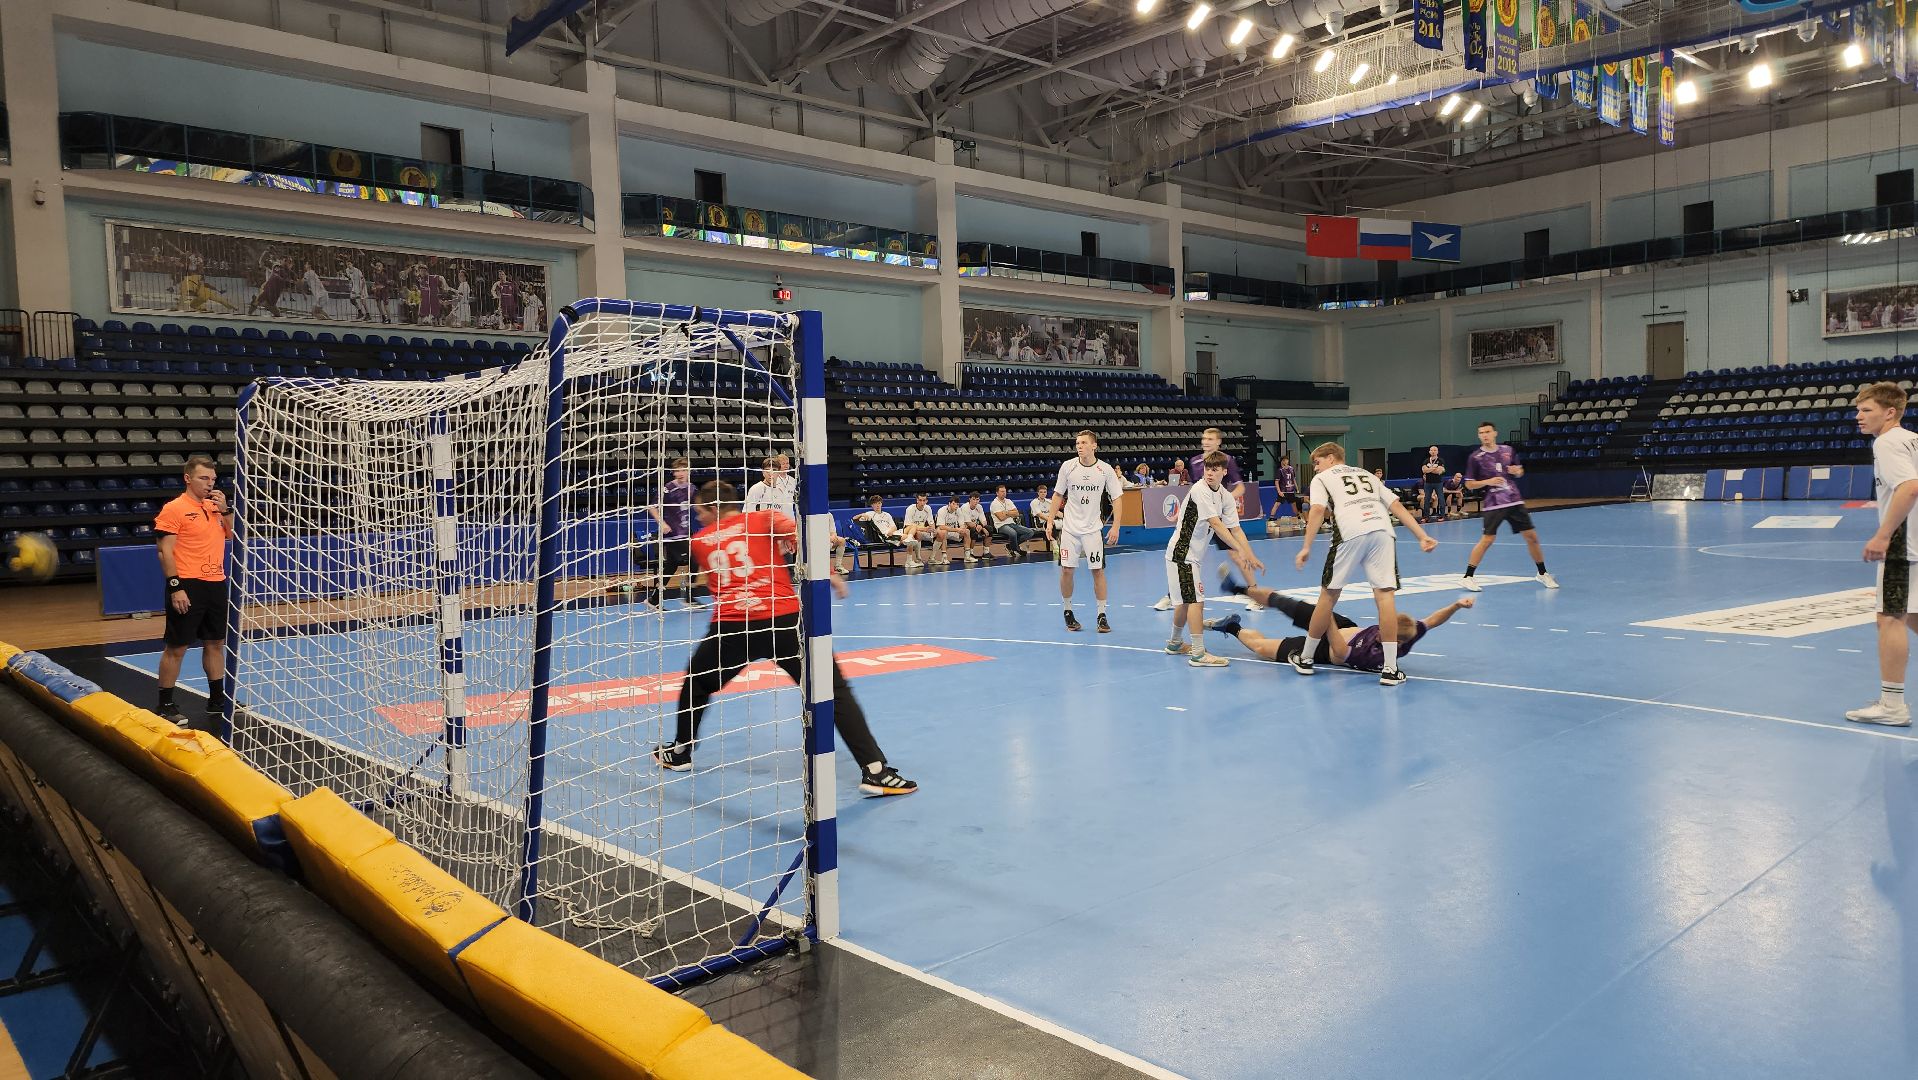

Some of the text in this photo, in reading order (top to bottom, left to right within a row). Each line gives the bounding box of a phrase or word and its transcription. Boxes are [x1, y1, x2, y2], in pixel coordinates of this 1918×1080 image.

[1497, 55, 1517, 75] 2012
[1341, 475, 1374, 495] 55
[1080, 495, 1090, 505] 66
[707, 540, 755, 587] 93
[1089, 551, 1100, 563] 66
